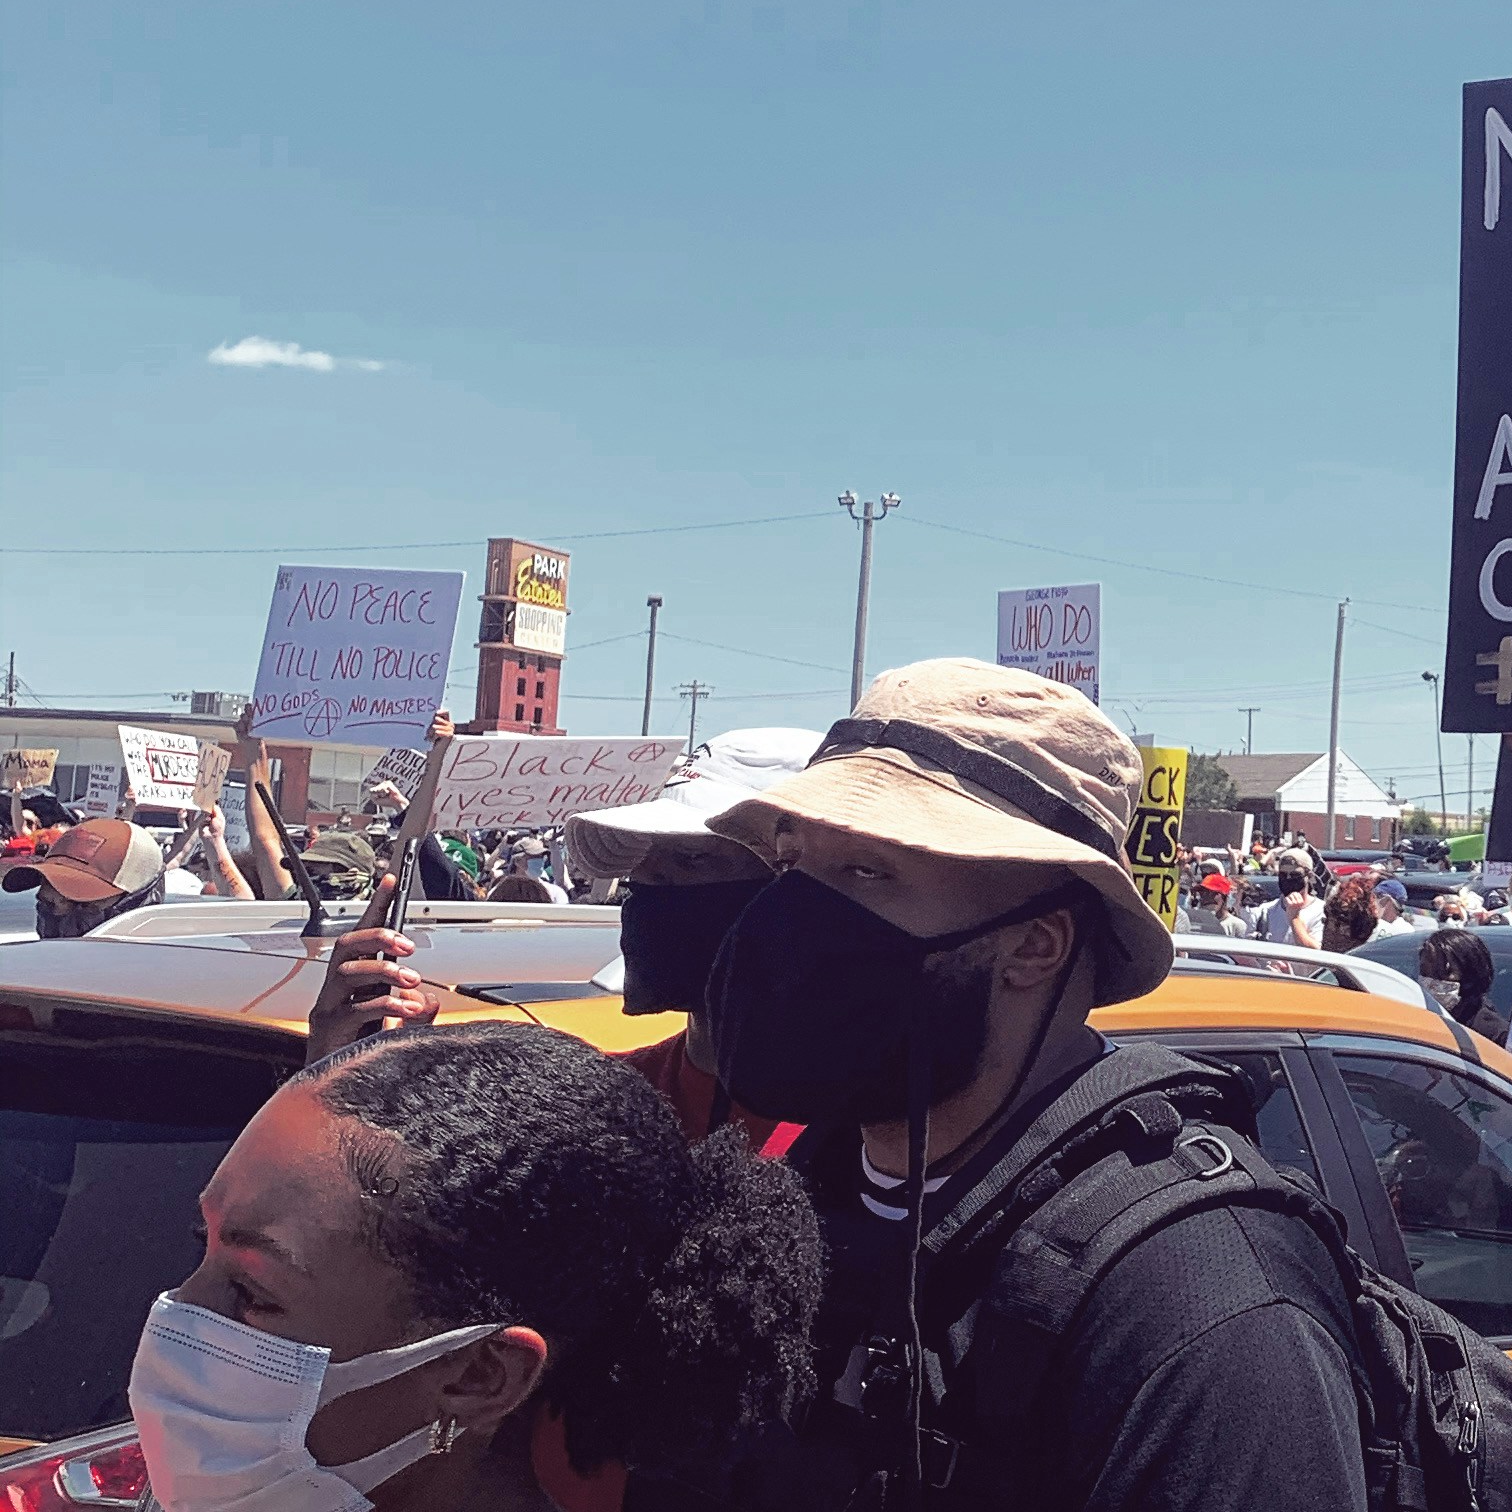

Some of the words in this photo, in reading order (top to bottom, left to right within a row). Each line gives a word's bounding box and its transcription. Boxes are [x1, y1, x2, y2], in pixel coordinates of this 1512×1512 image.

[516, 557, 565, 609] Estates
[533, 553, 566, 579] PARK
[287, 580, 340, 628] NO
[349, 582, 437, 626] PEACE
[518, 606, 563, 637] SHOPPING
[1011, 602, 1054, 652] WHO
[1061, 602, 1092, 646] DO
[330, 645, 364, 680] NO
[371, 645, 442, 681] POLICE
[252, 694, 277, 722] NO
[281, 688, 321, 713] GODS
[347, 694, 367, 716] NO
[369, 695, 438, 718] MASTERS
[446, 741, 615, 782] Black
[455, 809, 534, 829] FUCK
